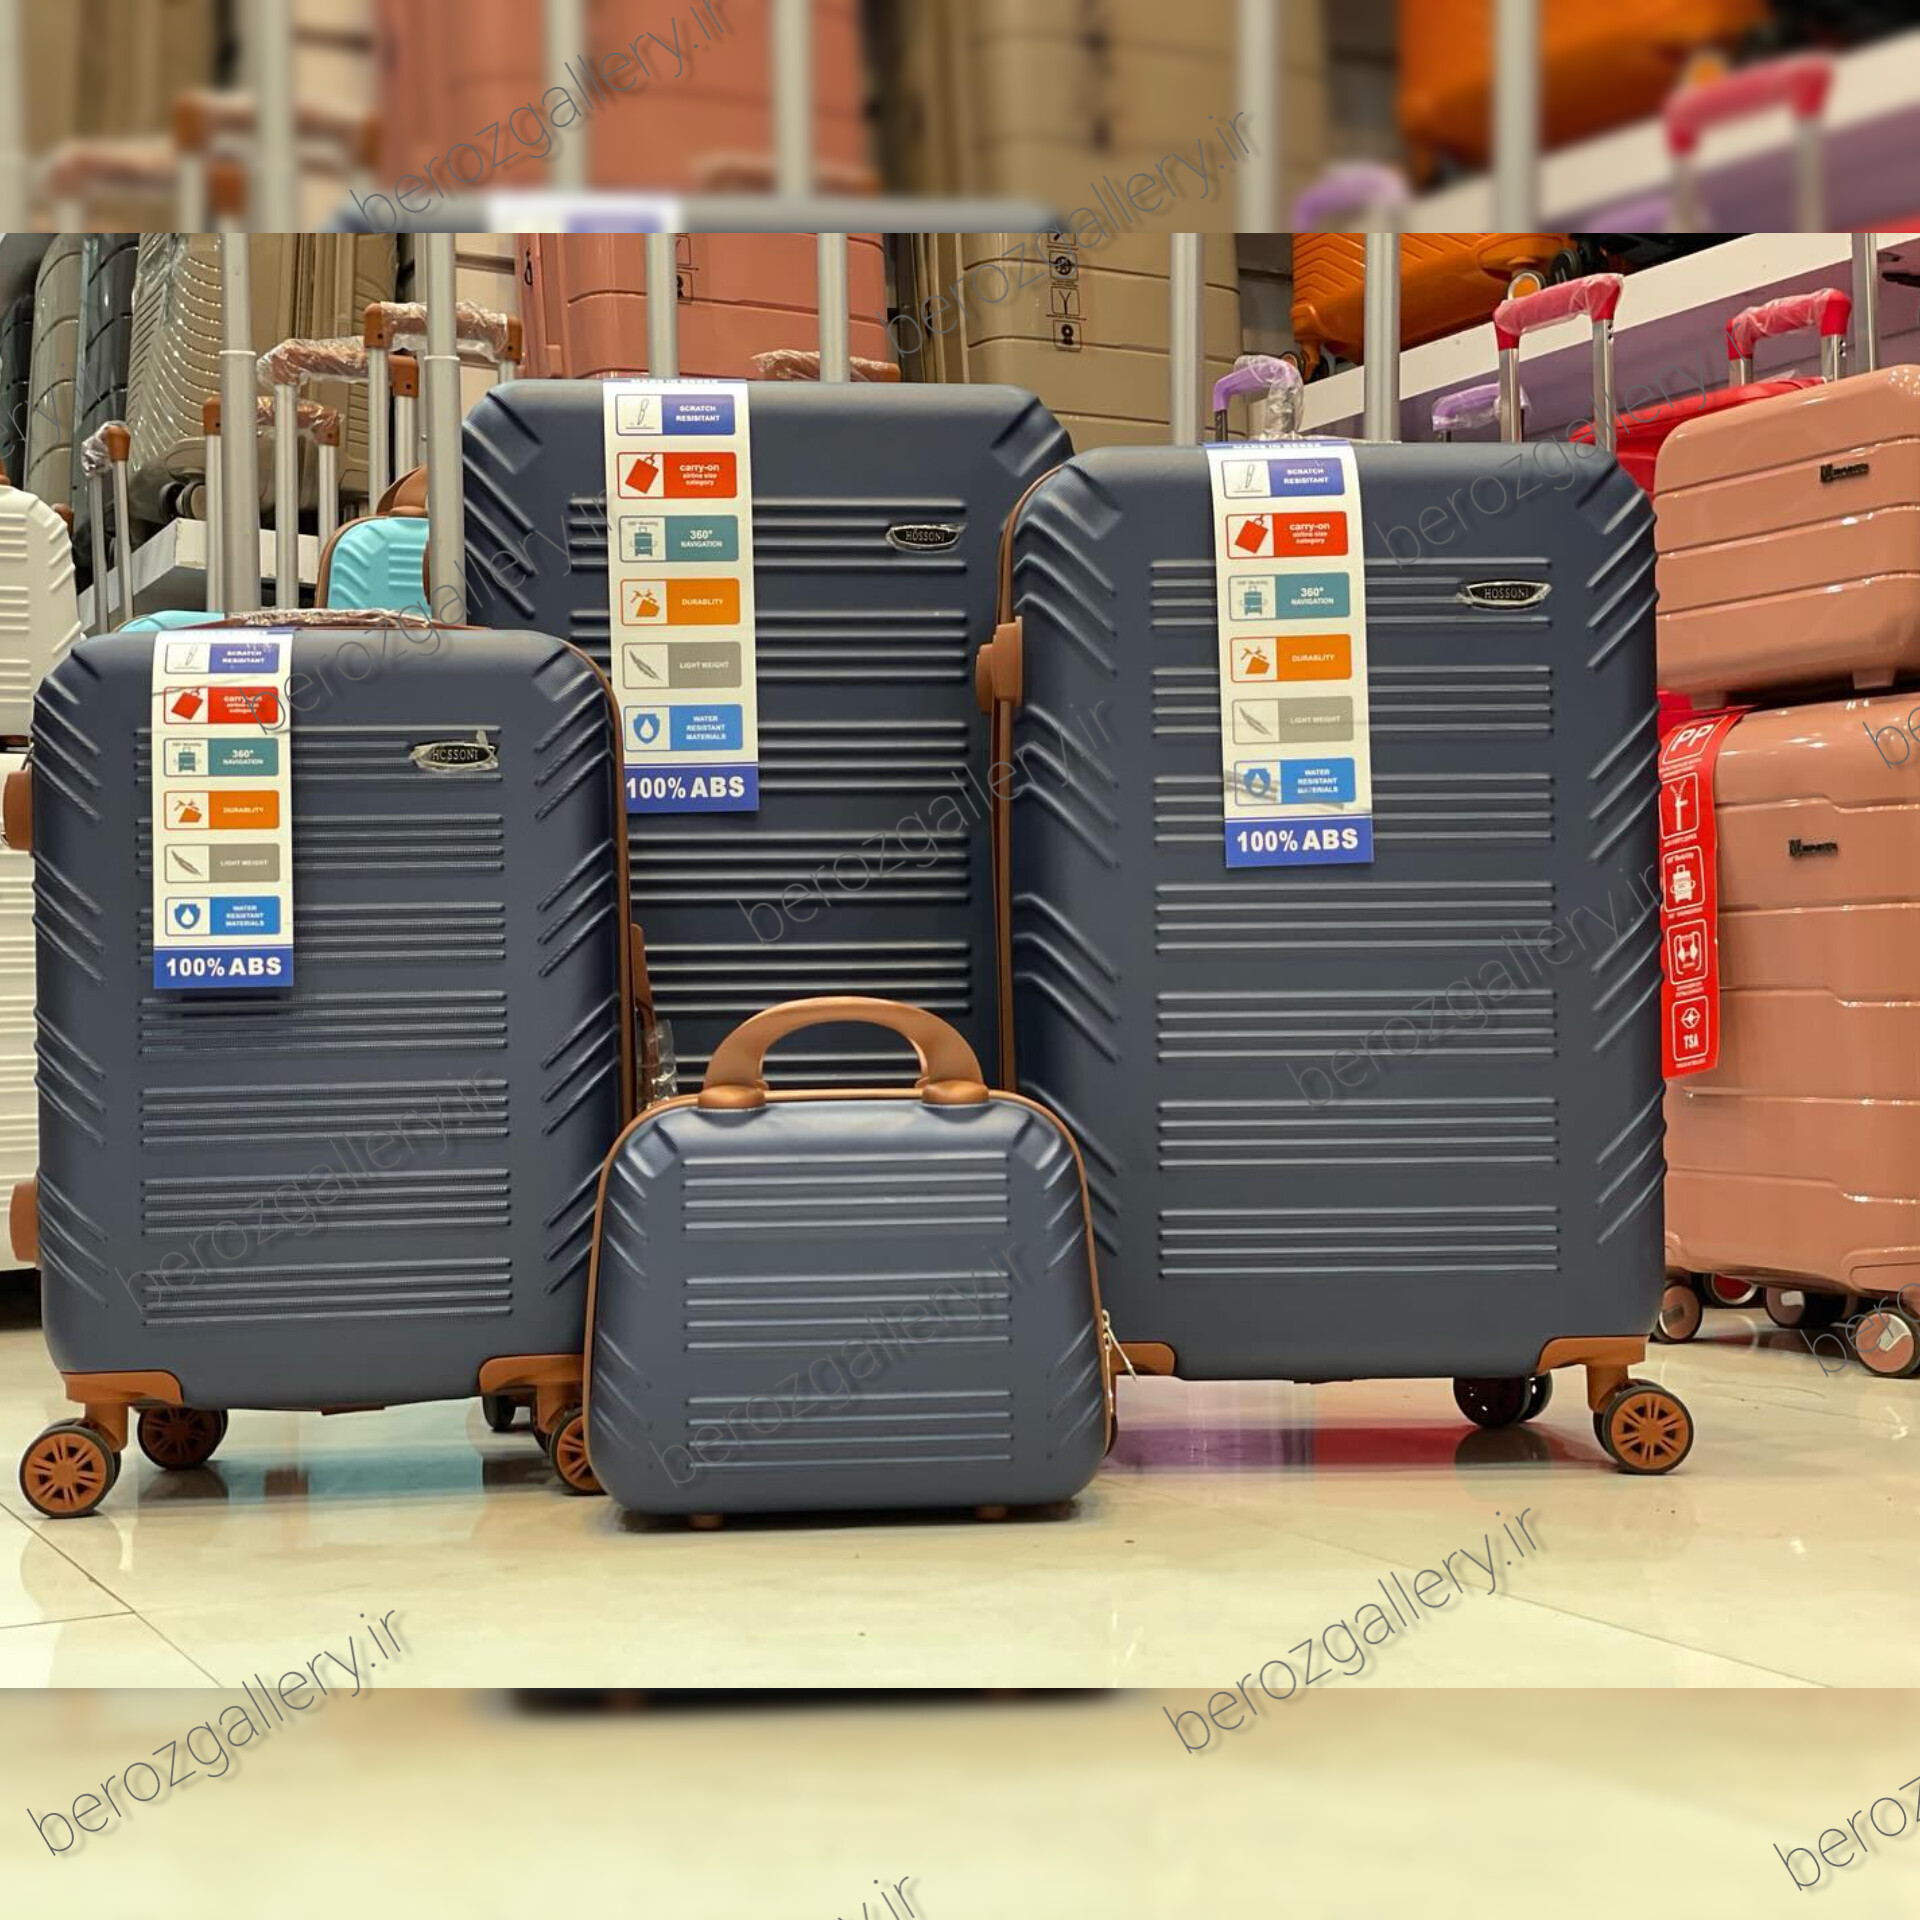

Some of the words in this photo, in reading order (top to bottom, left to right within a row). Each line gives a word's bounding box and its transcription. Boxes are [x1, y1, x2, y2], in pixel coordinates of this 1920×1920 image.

[679, 464, 720, 472] carry-on
[1287, 468, 1324, 476] SCRATCH
[1289, 523, 1330, 532] carry-on
[905, 530, 945, 541] HOSSONI
[1484, 587, 1529, 599] HOSSONI
[679, 661, 700, 669] LIGHT
[702, 661, 729, 669] WEIGHT
[1290, 716, 1311, 724] LIGHT
[1313, 715, 1341, 723] WEIGHT
[1671, 724, 1714, 751] PP
[1305, 768, 1330, 776] WATER
[1297, 777, 1338, 785] RESISTANT
[626, 777, 686, 799] 100%
[690, 776, 745, 798] ABS
[1297, 786, 1338, 794] MATERIALS
[1237, 830, 1298, 852] 100%
[1302, 828, 1358, 850] ABS
[166, 958, 225, 977] 100%
[229, 957, 282, 976] ABS
[1683, 1034, 1699, 1050] TSA
